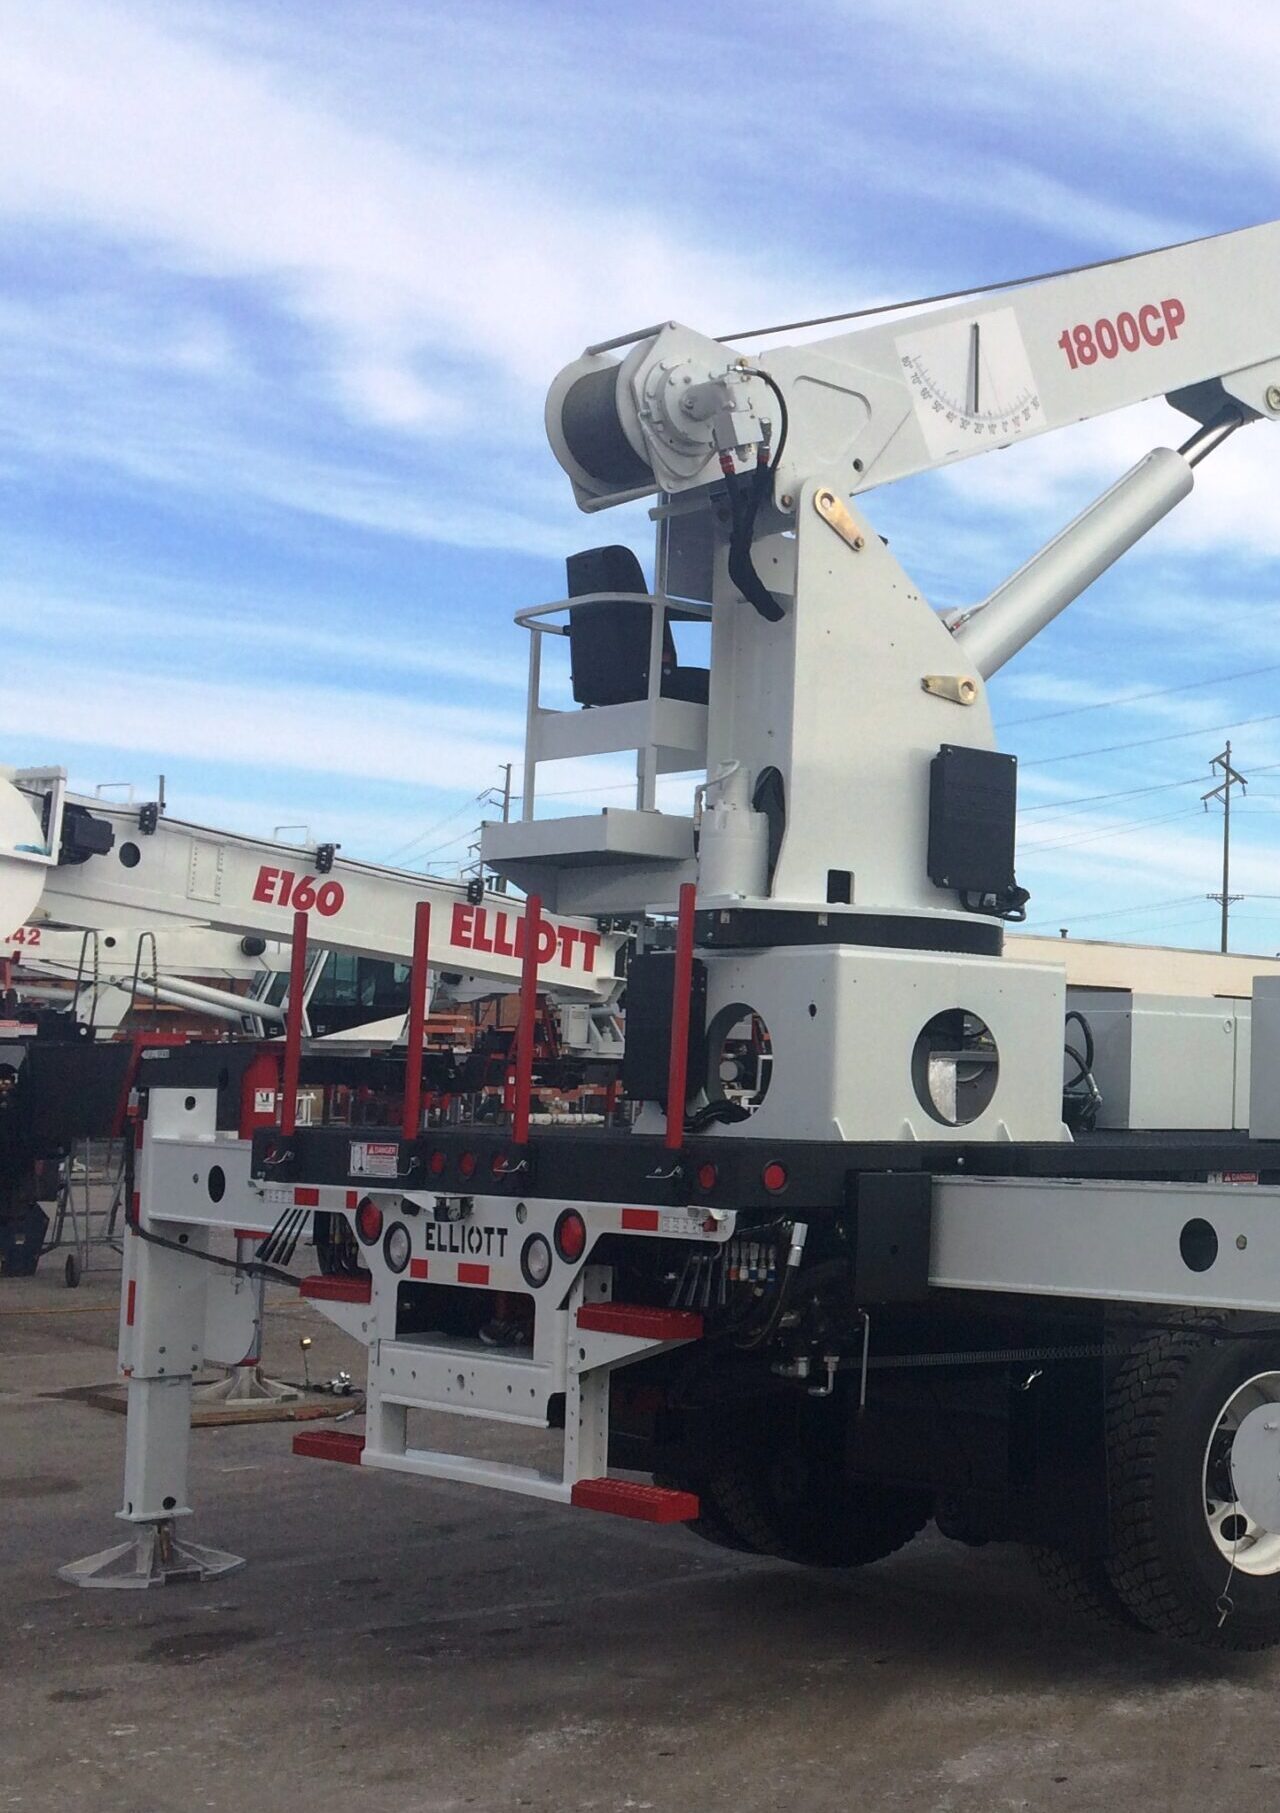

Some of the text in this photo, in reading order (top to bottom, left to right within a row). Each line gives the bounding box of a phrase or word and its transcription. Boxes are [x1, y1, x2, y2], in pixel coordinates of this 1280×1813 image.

[1059, 298, 1186, 369] 1800CP
[252, 865, 346, 916] E160
[4, 927, 41, 946] 42
[449, 903, 603, 974] ELLIOTT
[425, 1222, 509, 1258] ELLIOTT
